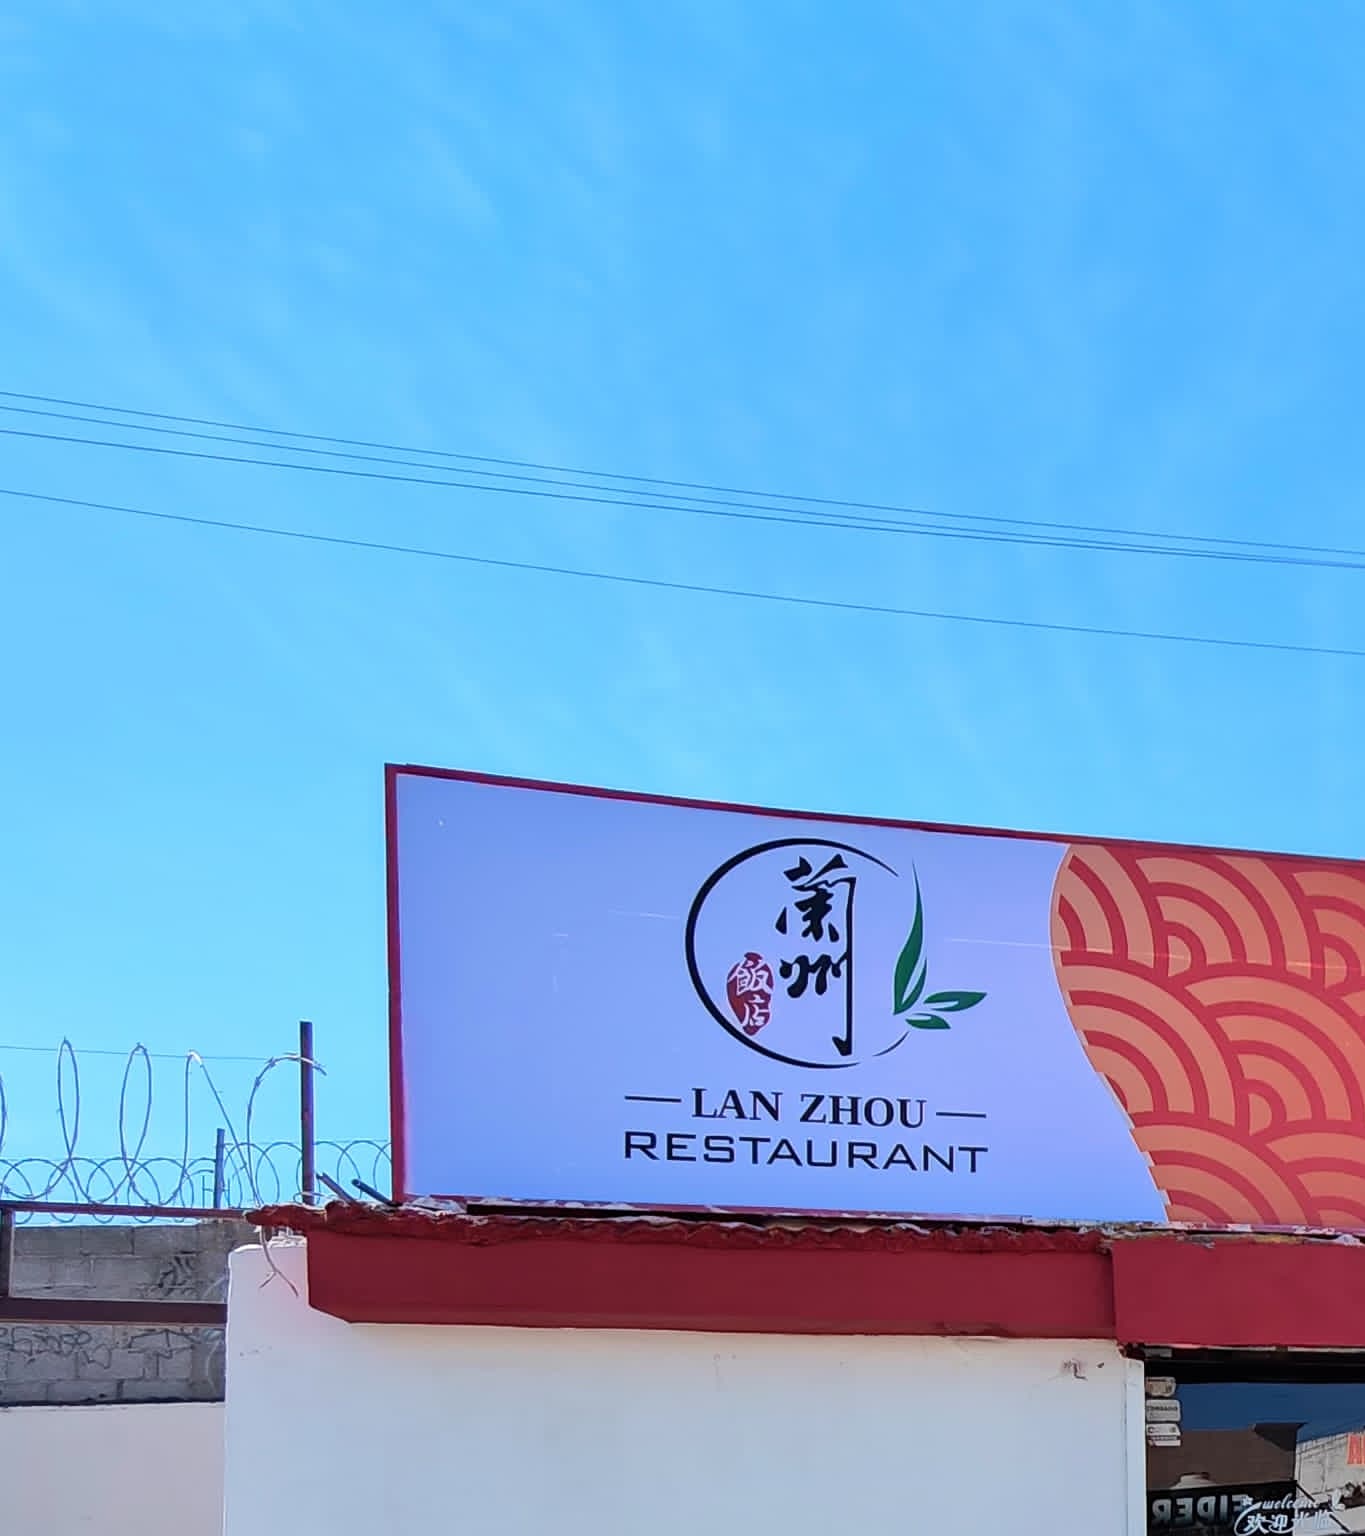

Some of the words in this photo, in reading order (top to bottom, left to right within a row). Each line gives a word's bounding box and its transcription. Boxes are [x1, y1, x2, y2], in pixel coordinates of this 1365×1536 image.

[728, 957, 775, 1030] 飯店
[691, 1087, 782, 1122] LAN
[799, 1092, 927, 1129] ZHOU
[623, 1131, 989, 1174] RESTAURANT
